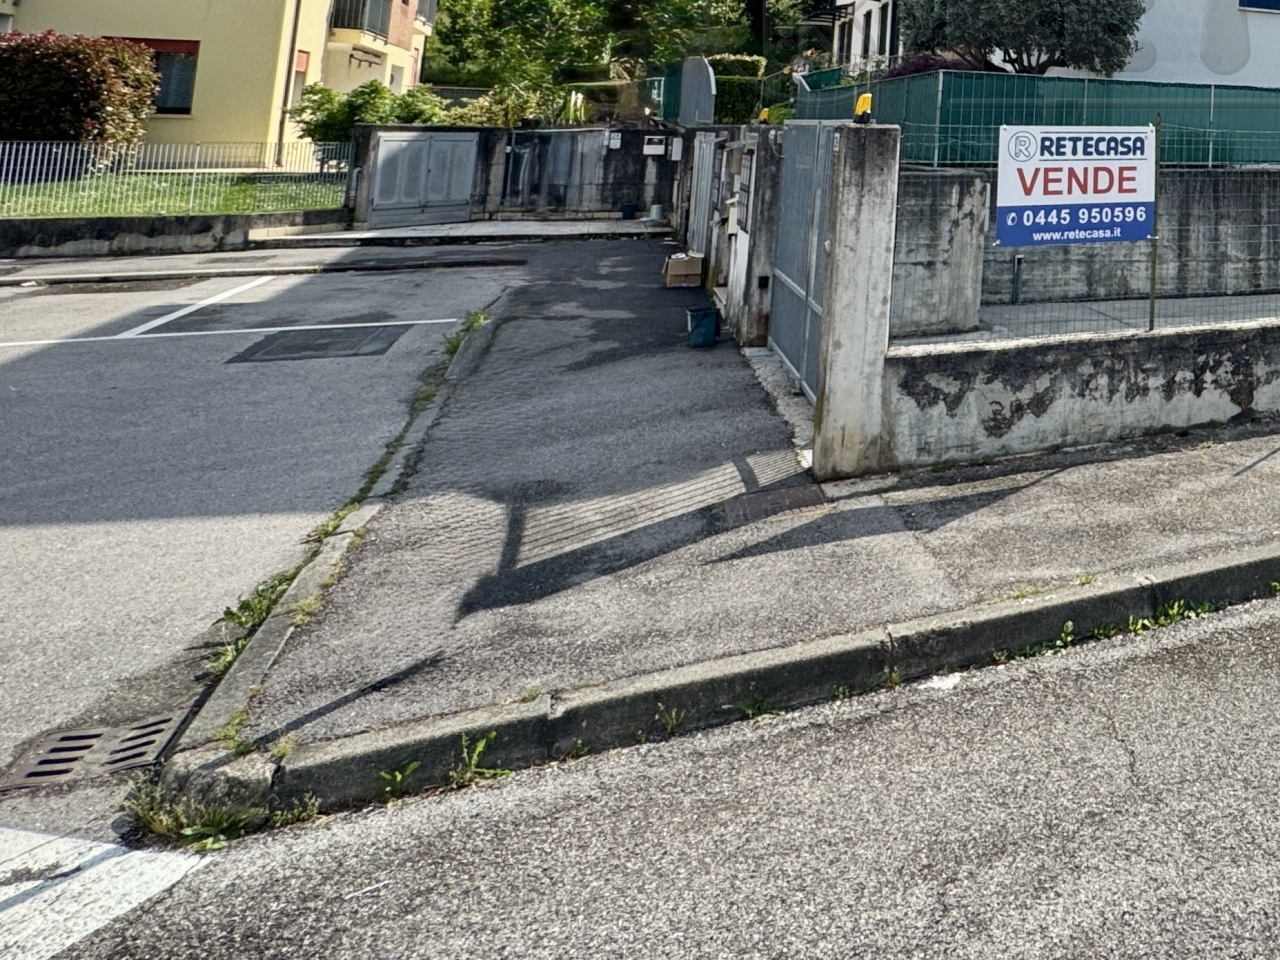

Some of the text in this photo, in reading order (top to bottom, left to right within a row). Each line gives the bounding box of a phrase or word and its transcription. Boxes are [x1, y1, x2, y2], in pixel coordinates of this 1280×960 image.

[1040, 136, 1145, 157] RETECASA
[1016, 166, 1137, 196] VENDE
[1023, 207, 1147, 226] 0445 950596
[1032, 227, 1121, 241] www.retecasa.it
